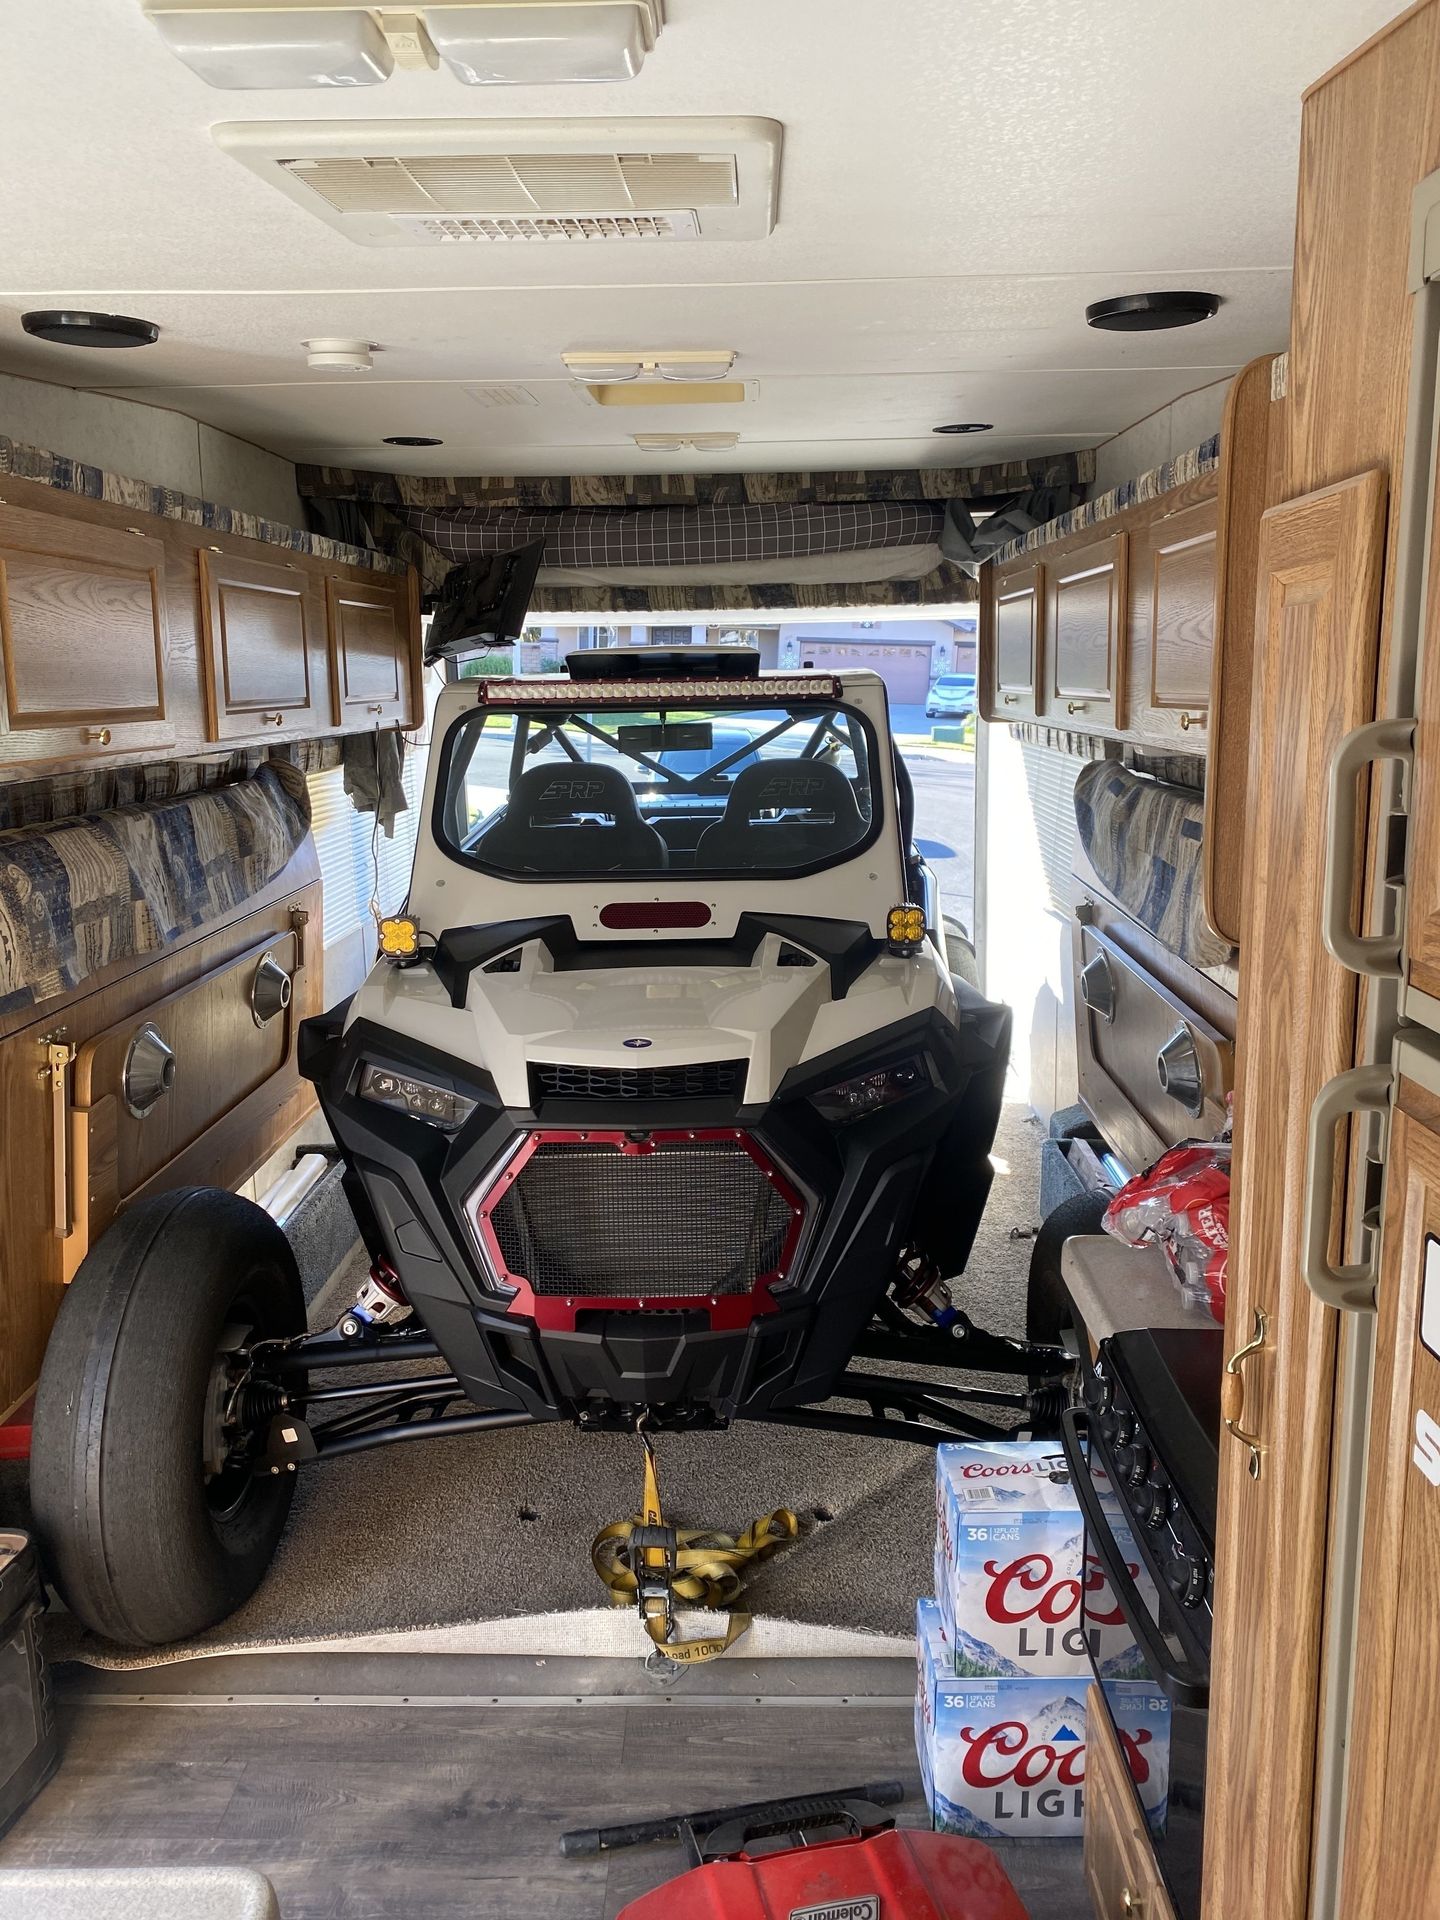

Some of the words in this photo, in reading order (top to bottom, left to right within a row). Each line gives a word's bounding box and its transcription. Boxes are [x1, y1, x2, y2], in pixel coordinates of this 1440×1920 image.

[539, 780, 606, 800] PRP
[1198, 1204, 1229, 1248] ATER
[960, 1463, 1032, 1479] Coors
[1036, 1458, 1070, 1472] LIG
[967, 1527, 988, 1541] 36
[992, 1533, 1021, 1541] CANS
[944, 1695, 964, 1708] 36
[969, 1700, 996, 1708] CANS
